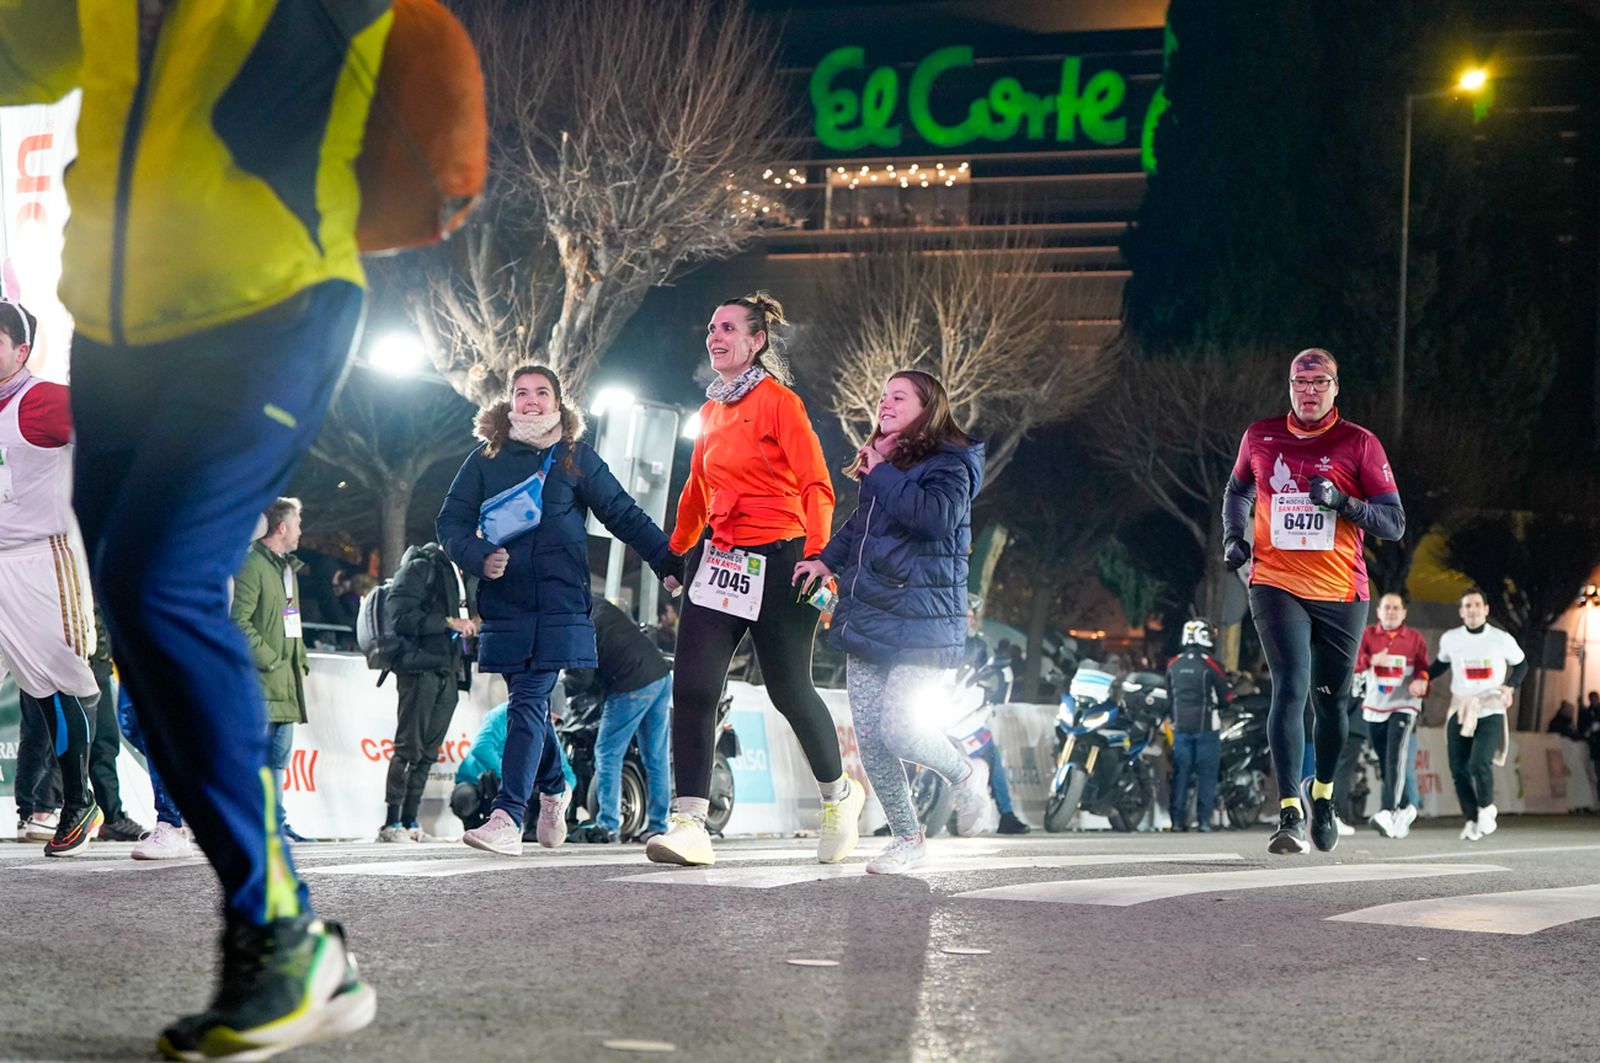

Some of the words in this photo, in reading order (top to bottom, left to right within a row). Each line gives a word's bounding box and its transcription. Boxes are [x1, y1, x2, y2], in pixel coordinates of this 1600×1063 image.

[810, 46, 902, 150] El
[909, 45, 1127, 147] Corte
[1284, 512, 1324, 530] 6470
[708, 566, 751, 595] 7045
